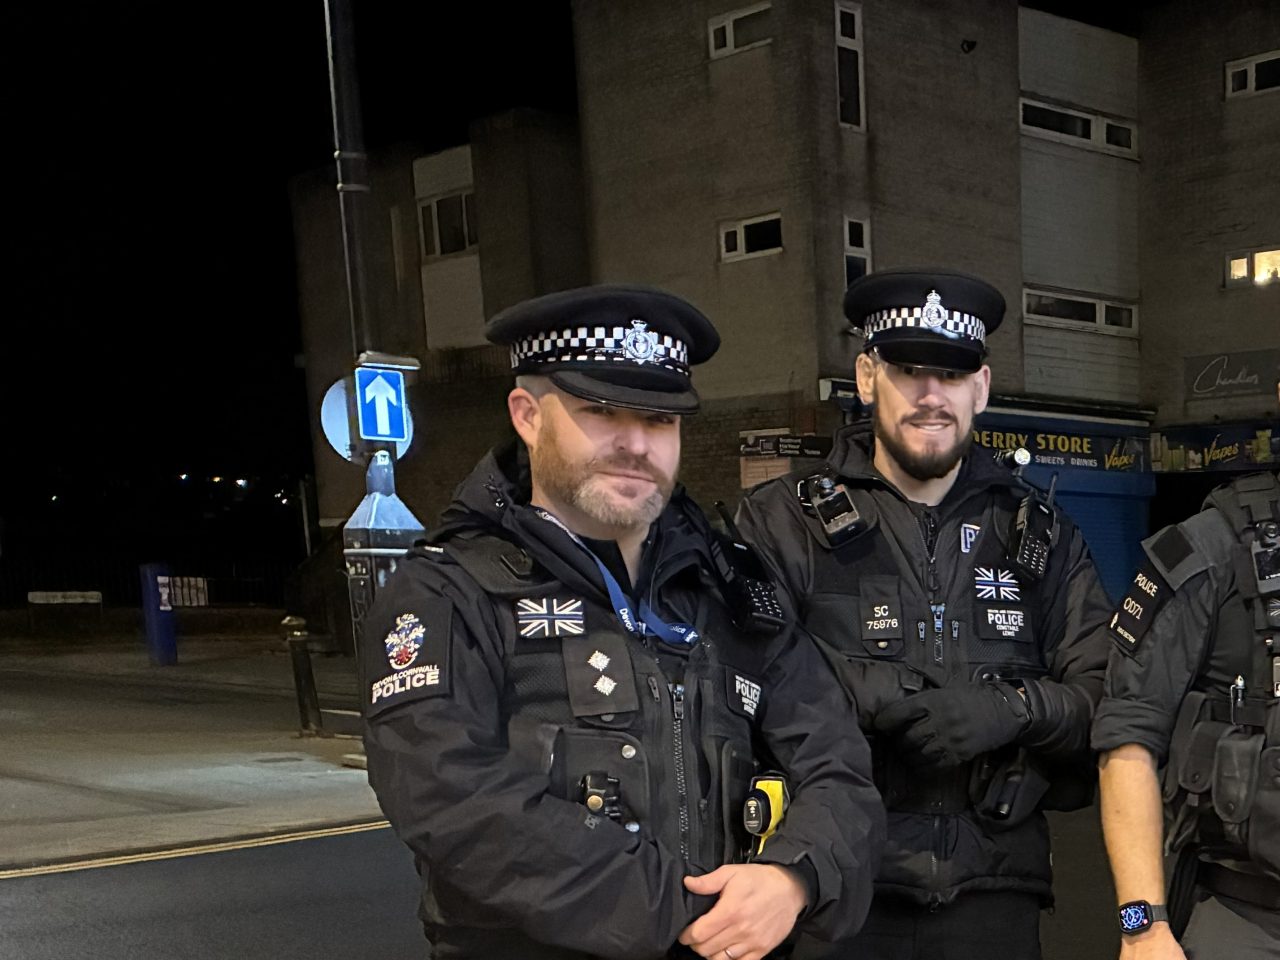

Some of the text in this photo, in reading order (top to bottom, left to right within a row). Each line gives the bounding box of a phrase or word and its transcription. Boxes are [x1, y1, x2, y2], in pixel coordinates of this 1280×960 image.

[1036, 433, 1092, 454] STORE
[1104, 438, 1136, 471] Vapes
[1204, 434, 1239, 466] Vapes
[1134, 573, 1158, 597] POLICE
[620, 608, 634, 632] Devon
[873, 605, 889, 618] SC
[987, 613, 1025, 627] POLICE
[866, 618, 898, 630] 75976
[372, 670, 439, 704] POLICE
